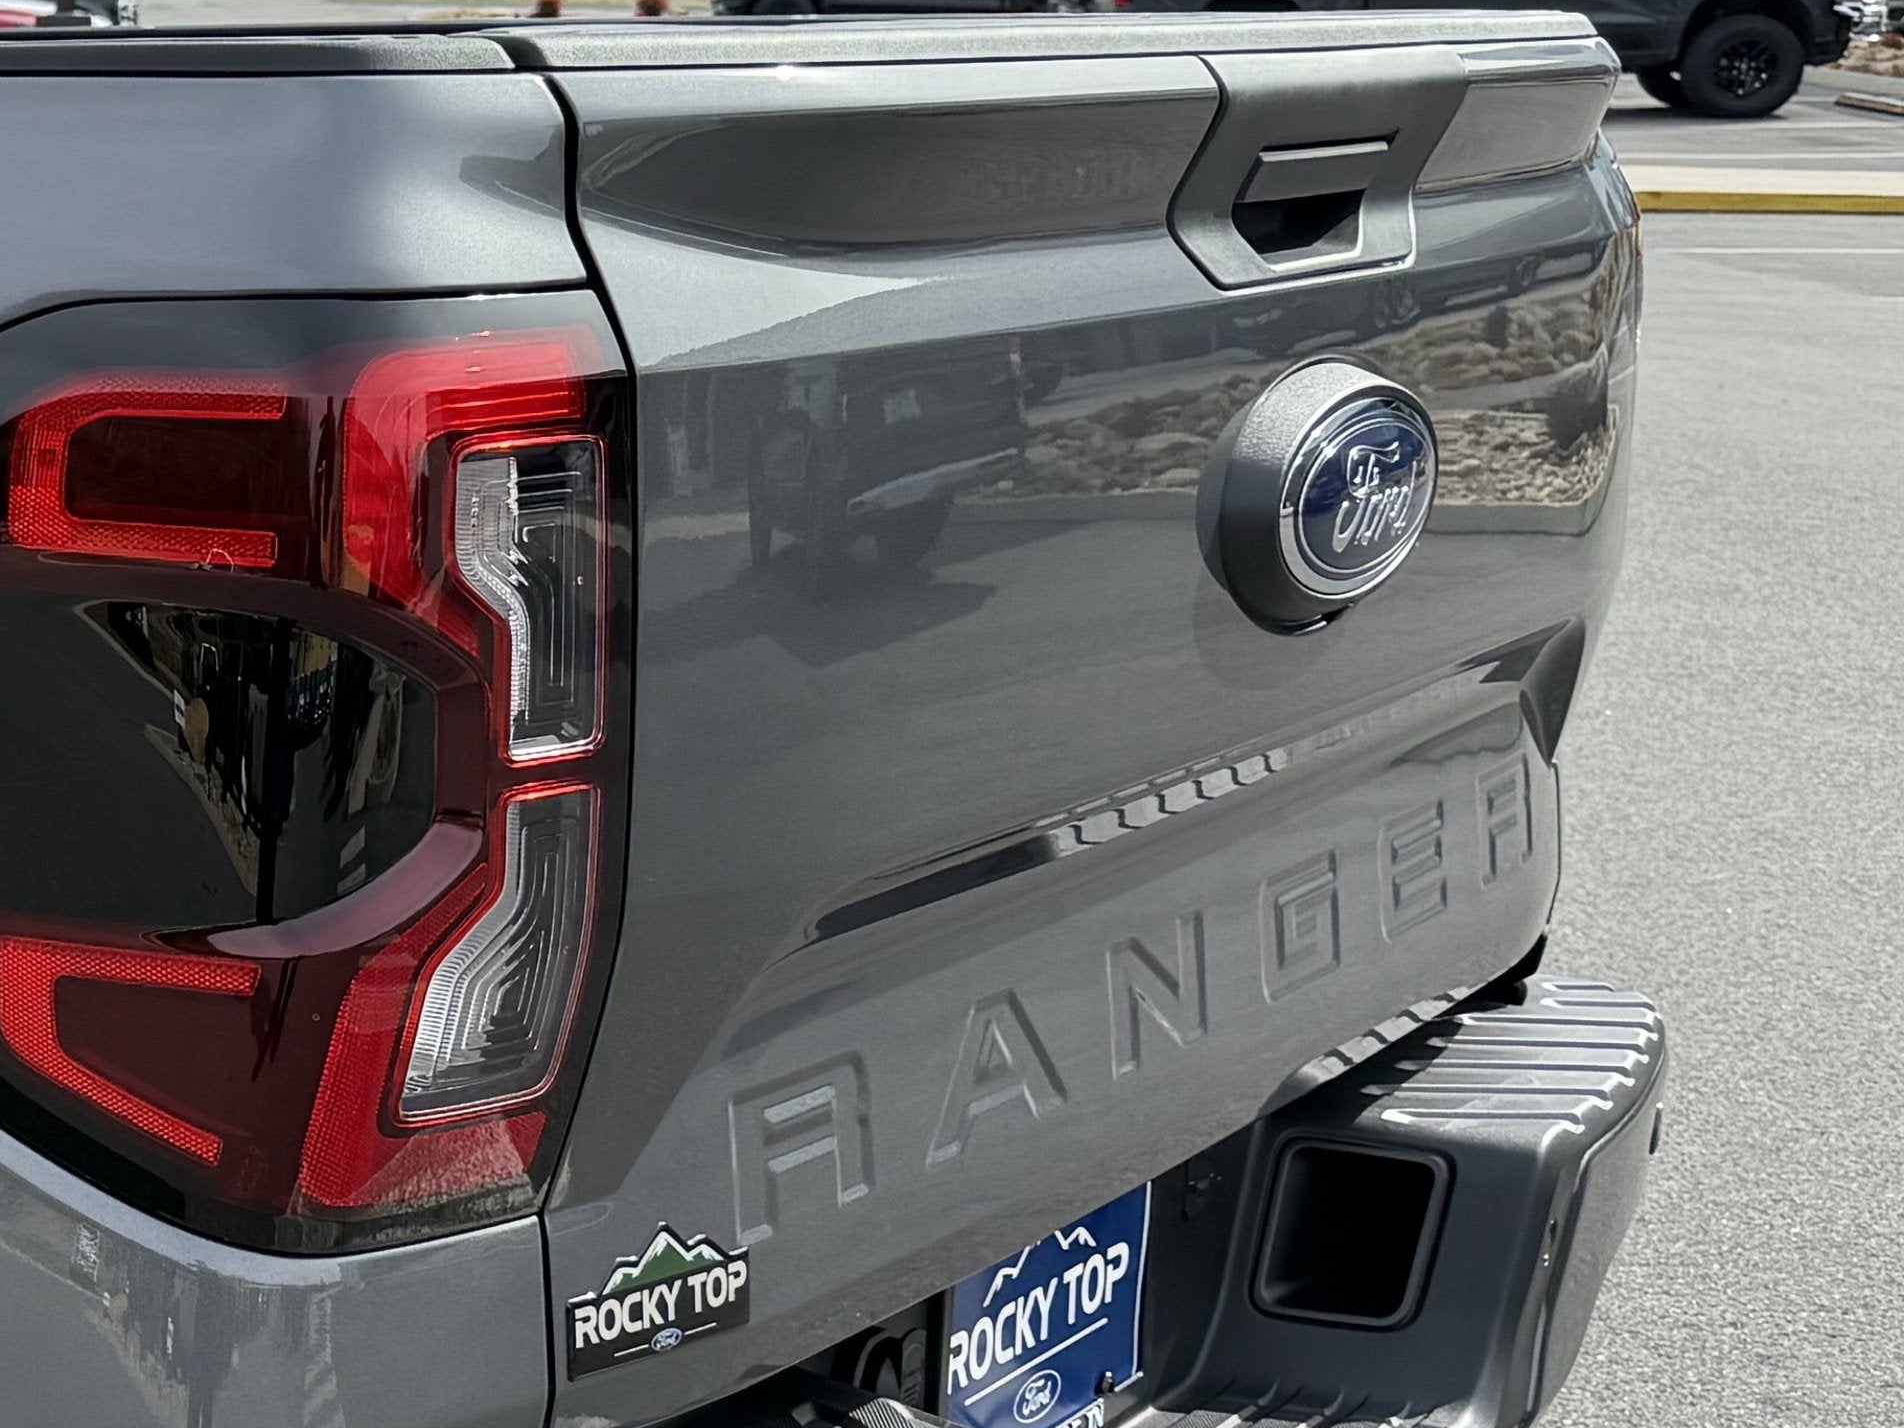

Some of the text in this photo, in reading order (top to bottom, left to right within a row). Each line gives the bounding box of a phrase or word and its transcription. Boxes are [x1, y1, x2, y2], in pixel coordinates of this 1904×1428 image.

[1331, 440, 1419, 553] Ford
[727, 754, 1535, 1246] RANGER
[574, 1260, 748, 1349] ROCKY TOP
[947, 1241, 1130, 1396] ROCKY TOP
[1021, 1377, 1052, 1417] Ford
